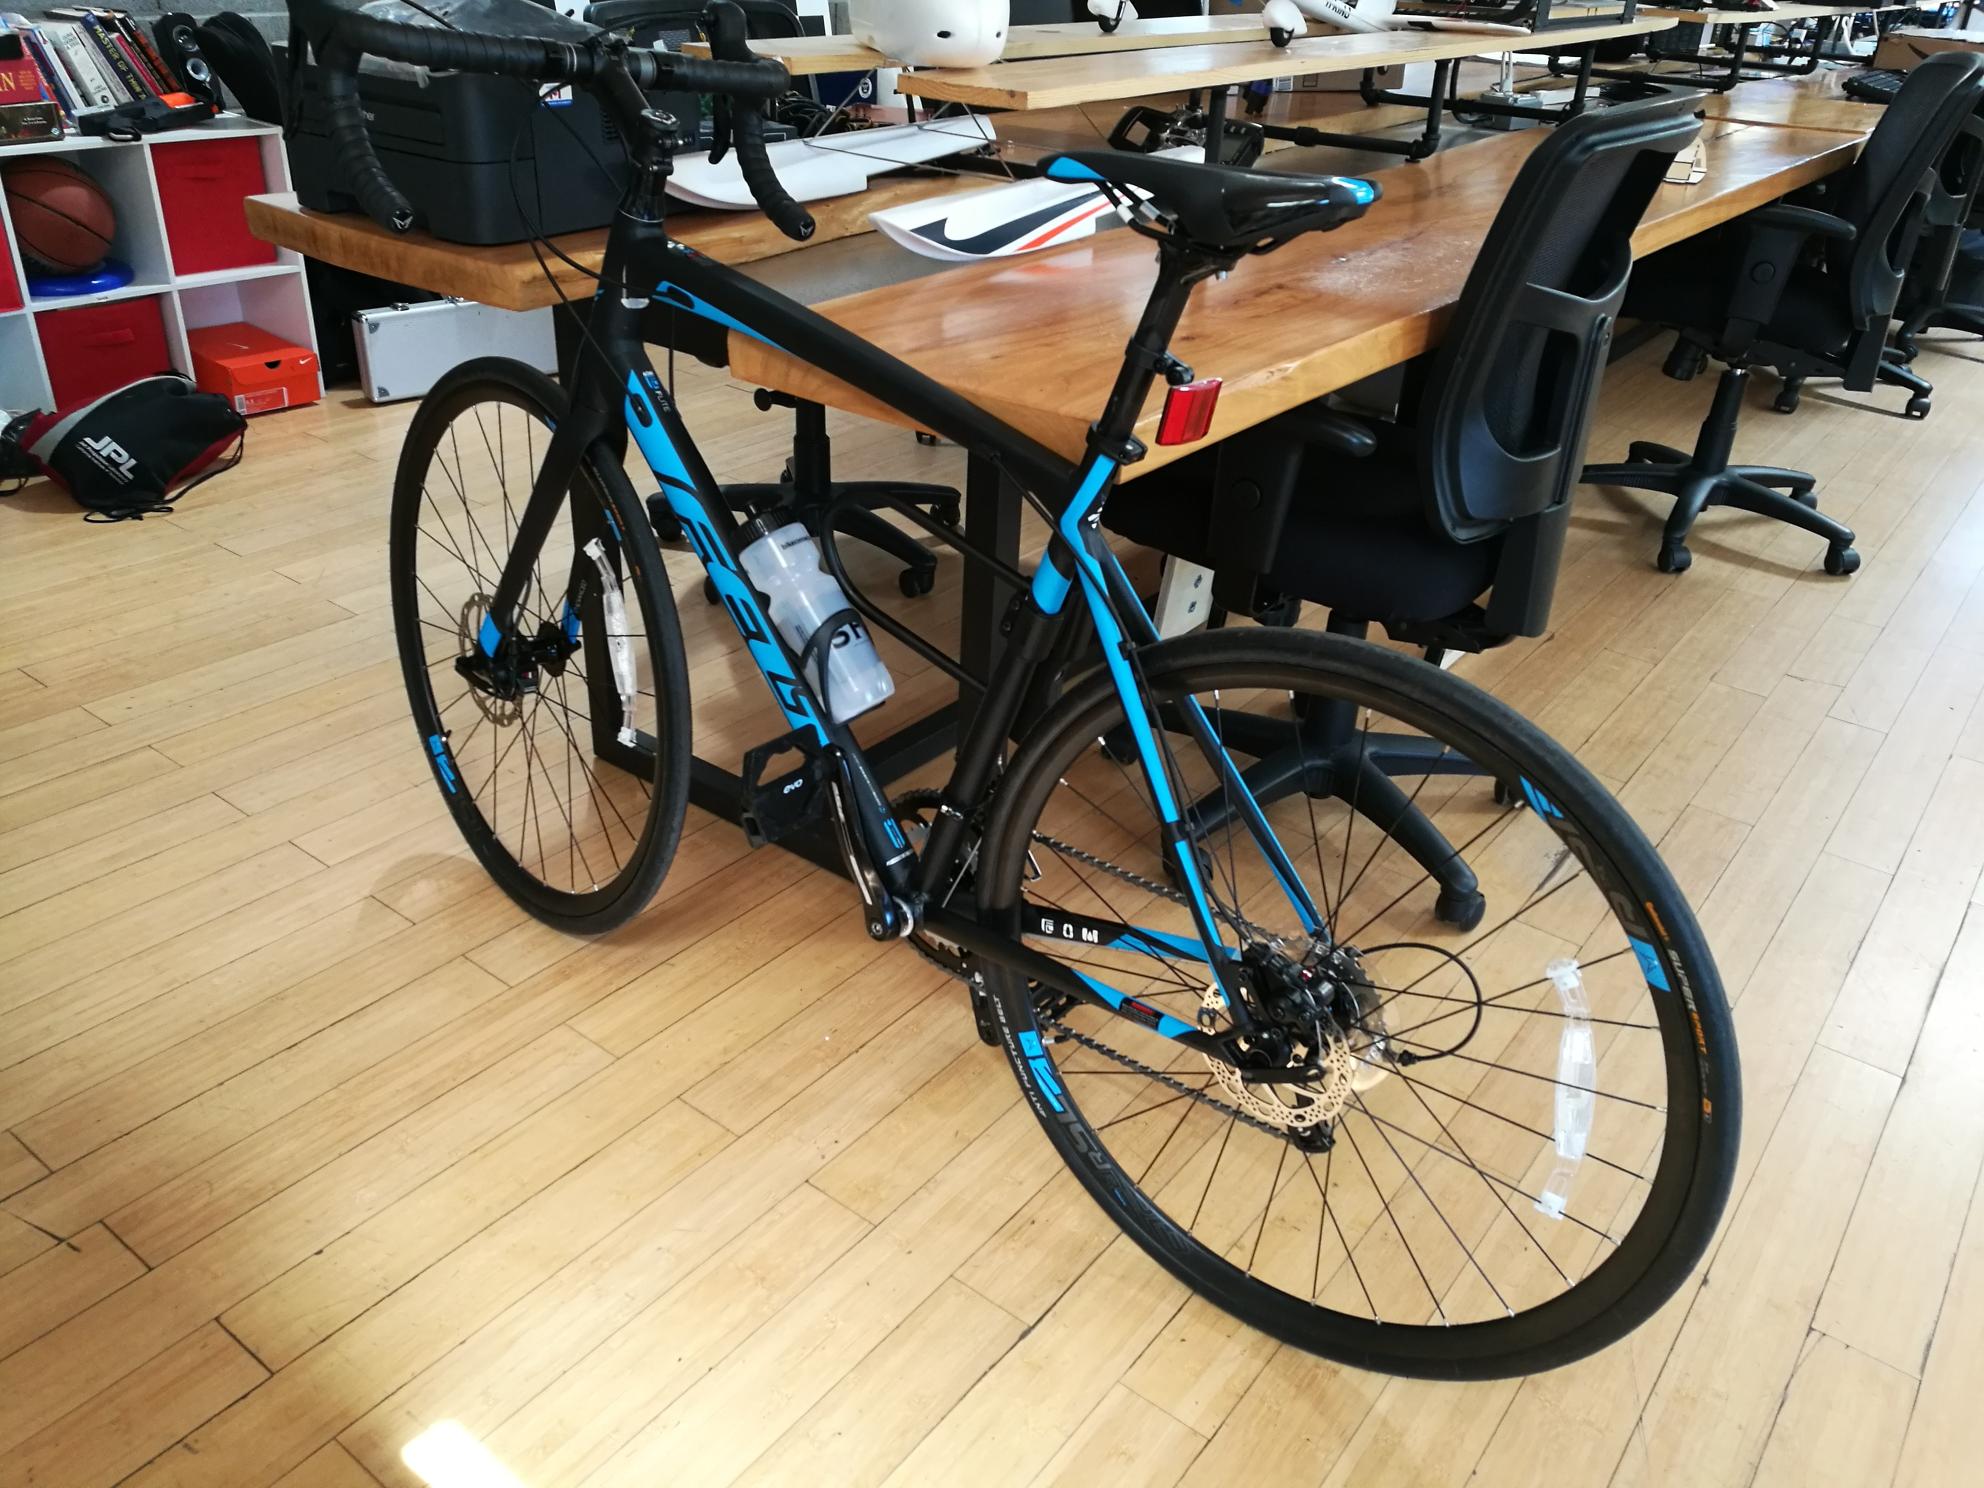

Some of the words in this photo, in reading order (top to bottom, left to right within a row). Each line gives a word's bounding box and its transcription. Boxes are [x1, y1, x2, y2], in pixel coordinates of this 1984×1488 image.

[93, 24, 120, 60] MASTER
[117, 60, 129, 72] OF
[82, 435, 137, 480] JPL
[783, 778, 804, 794] evo
[1667, 949, 1698, 1012] SUPER
[992, 993, 1007, 1025] BELT
[1001, 1025, 1032, 1089] PUNCTURE
[1028, 1090, 1048, 1120] ANTI
